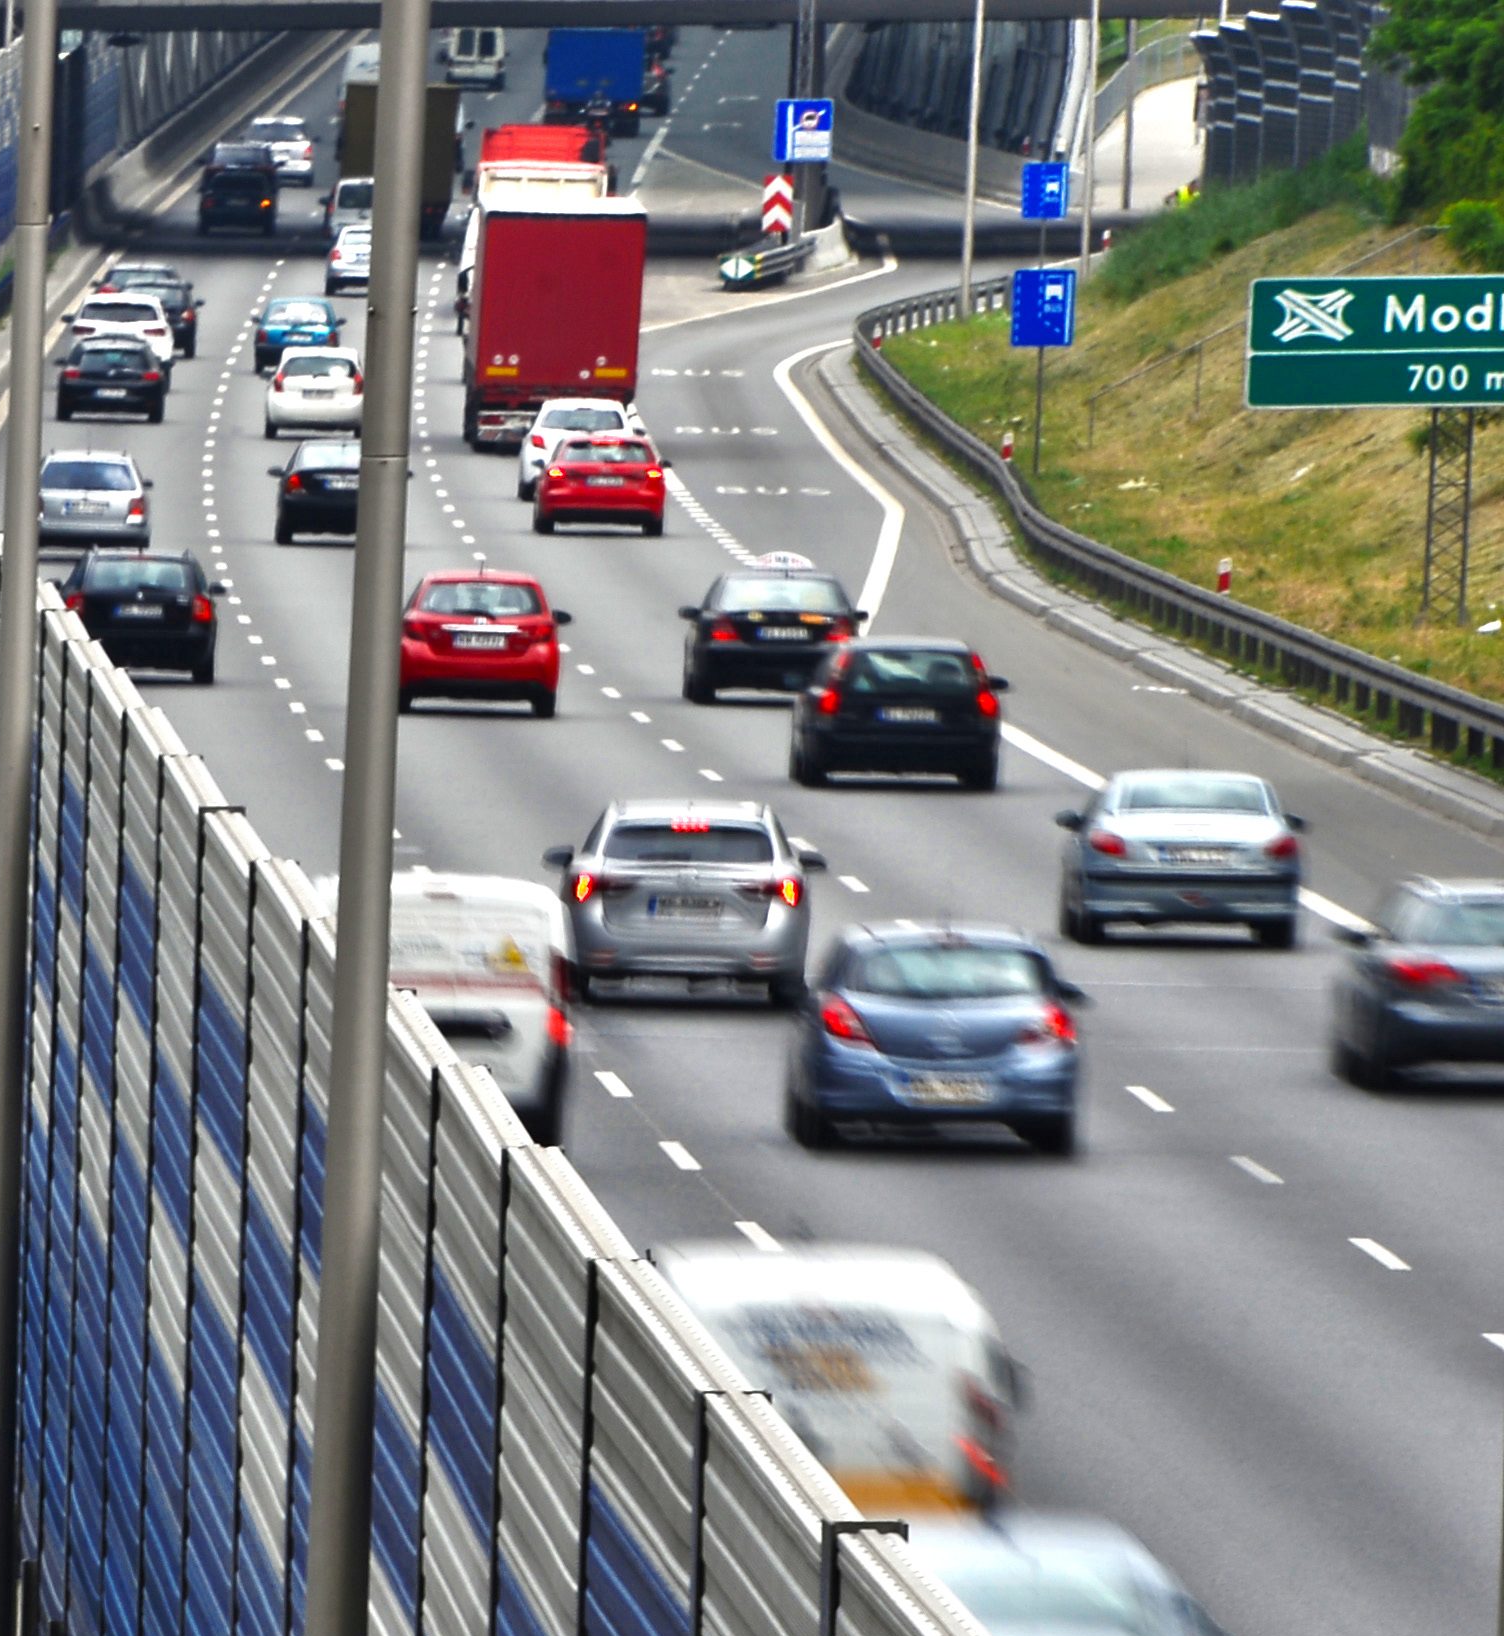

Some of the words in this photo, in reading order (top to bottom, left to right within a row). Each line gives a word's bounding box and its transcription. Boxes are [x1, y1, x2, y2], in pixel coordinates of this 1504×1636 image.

[1408, 364, 1469, 392] 700
[674, 425, 779, 435] BUS
[716, 486, 832, 496] BUS
